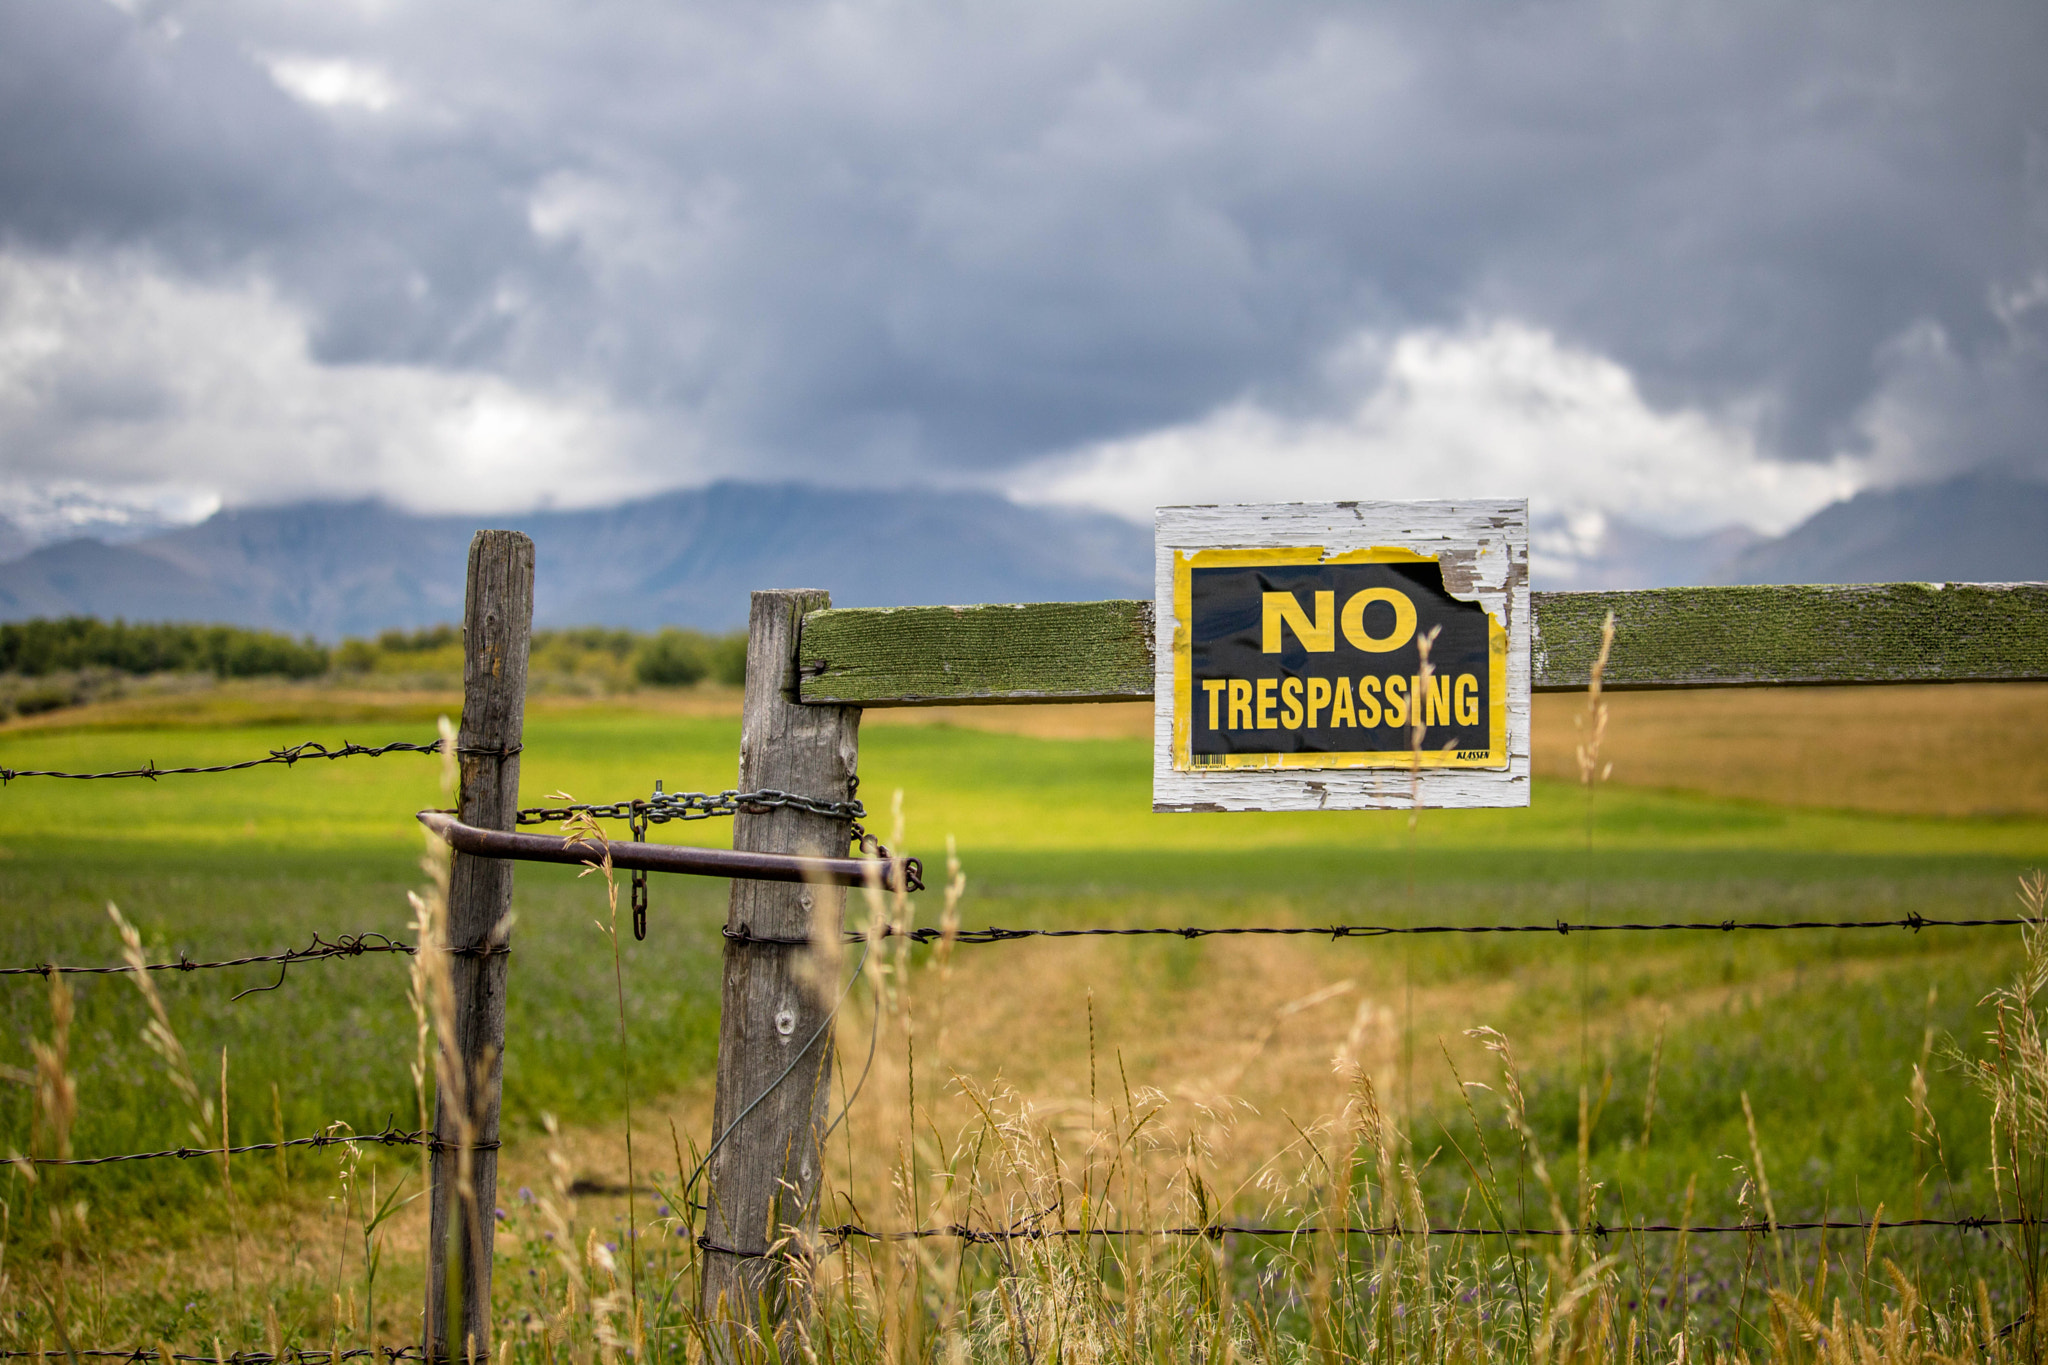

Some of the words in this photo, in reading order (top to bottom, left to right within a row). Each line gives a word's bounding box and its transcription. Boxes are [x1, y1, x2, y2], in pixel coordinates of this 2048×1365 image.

[1262, 587, 1417, 653] NO
[1202, 673, 1479, 730] TRESPASSING
[1456, 751, 1489, 759] KLASSEN
